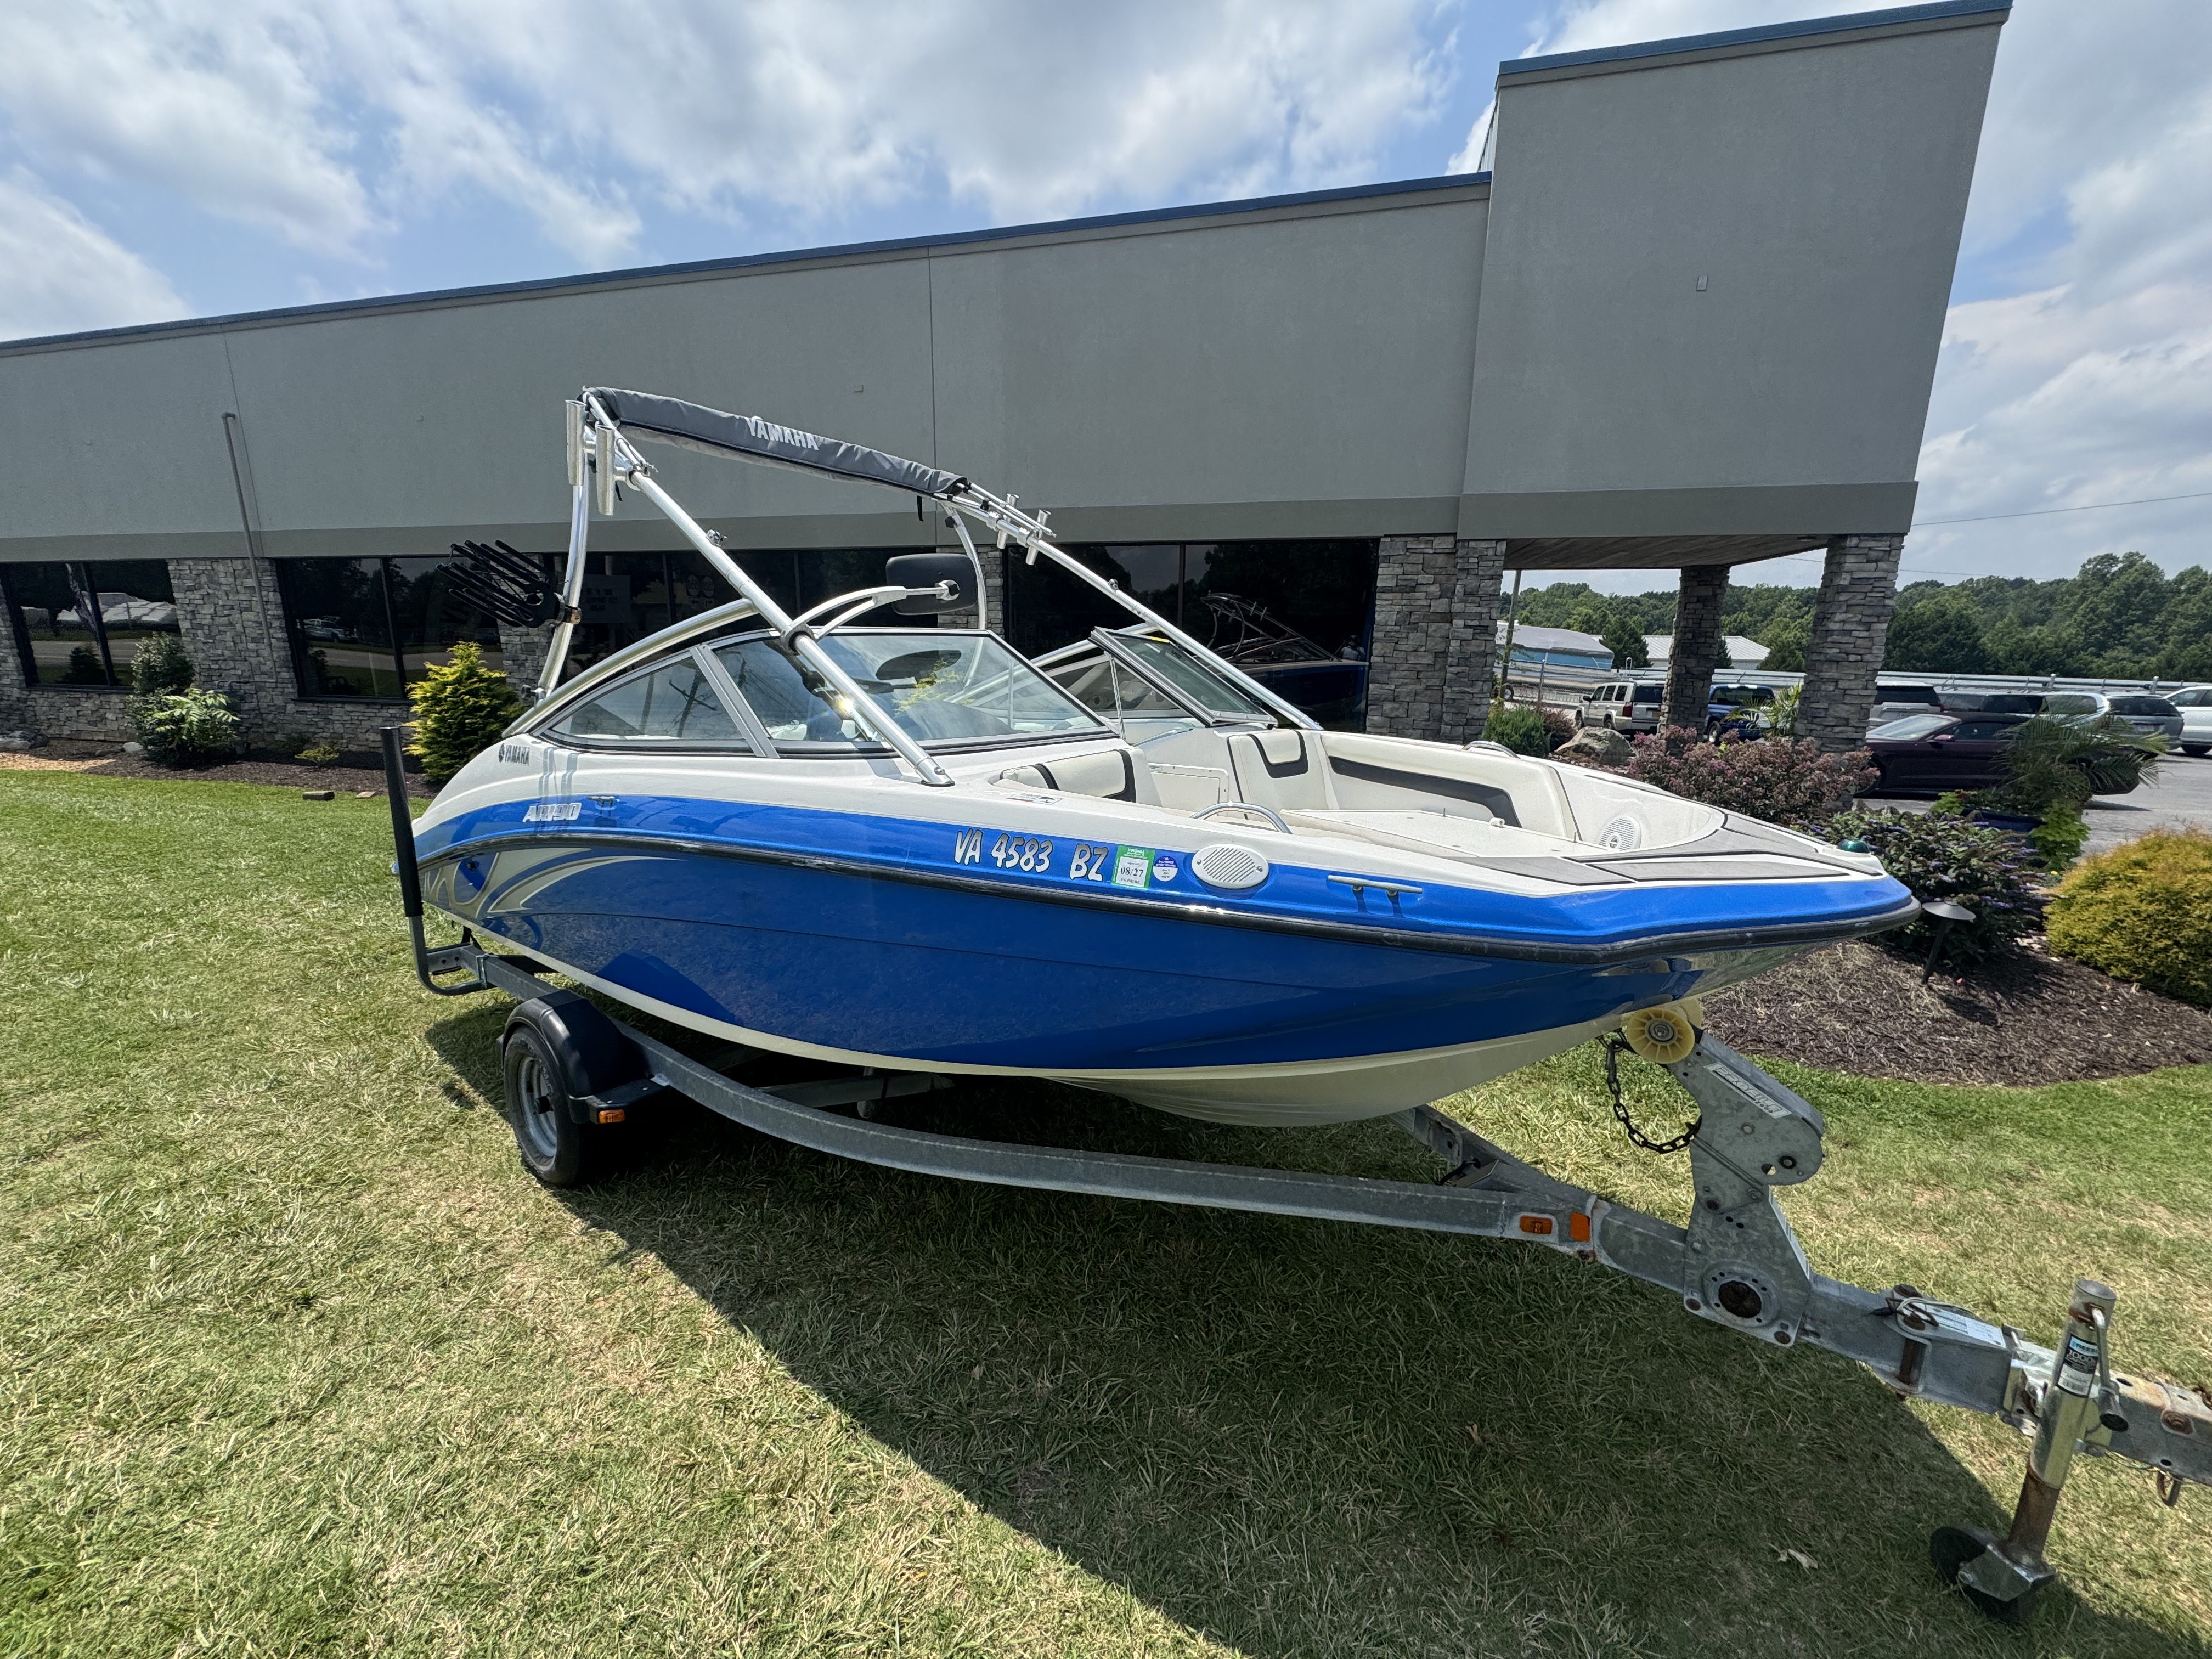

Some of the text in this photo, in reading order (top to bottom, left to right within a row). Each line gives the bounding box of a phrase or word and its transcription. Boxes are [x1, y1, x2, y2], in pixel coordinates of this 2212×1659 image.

[744, 417, 819, 450] YAMAHA
[505, 744, 531, 766] YAMAHA
[522, 802, 582, 822] AR190
[954, 827, 984, 865] VA
[991, 833, 1053, 873] 4583
[1070, 843, 1109, 882] BZ
[1120, 866, 1144, 877] 08/27
[1714, 1067, 1784, 1113] PROFILE
[2067, 1348, 2093, 1363] 1000
